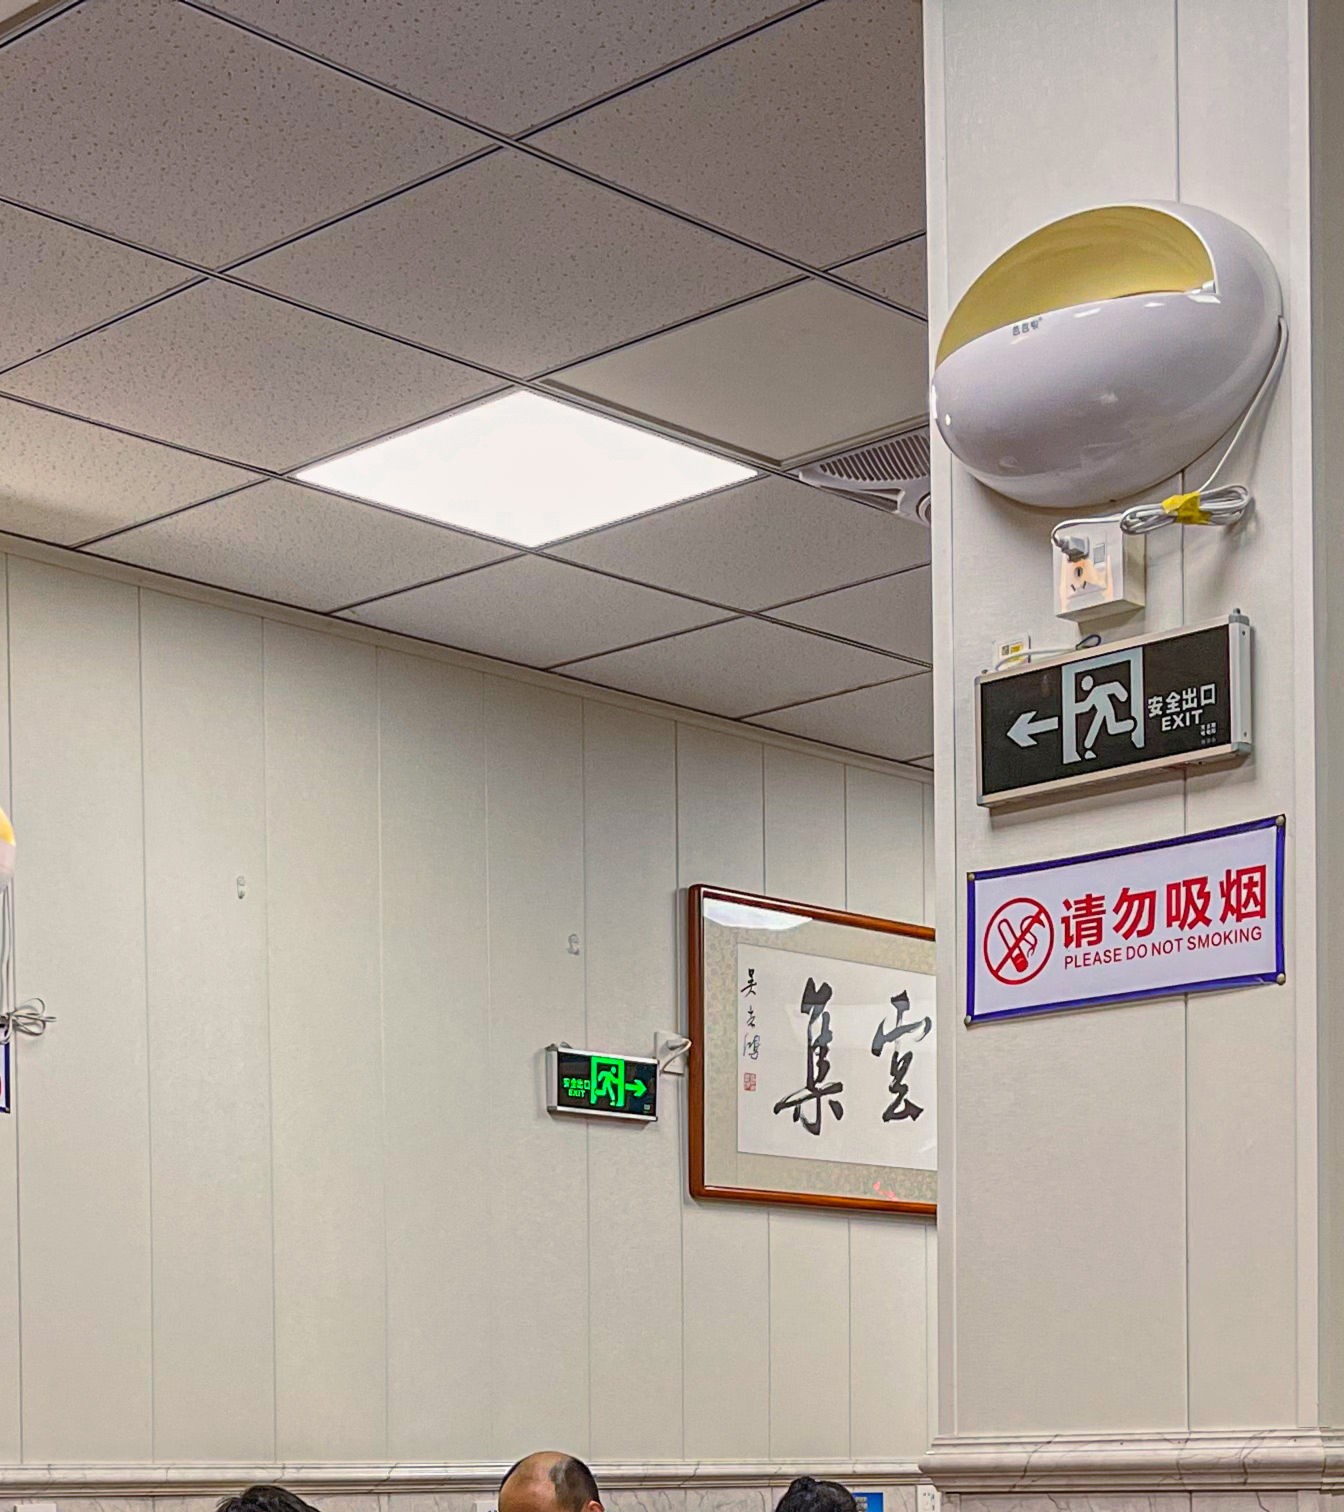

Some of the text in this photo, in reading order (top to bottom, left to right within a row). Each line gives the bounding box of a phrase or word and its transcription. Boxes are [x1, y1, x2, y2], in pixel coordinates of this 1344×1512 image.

[1147, 683, 1216, 718] 安全出口
[1161, 709, 1203, 732] EXIT
[1060, 864, 1267, 949] 请勿吸烟
[1064, 926, 1262, 970] PLEASE DO NOT SMOKING
